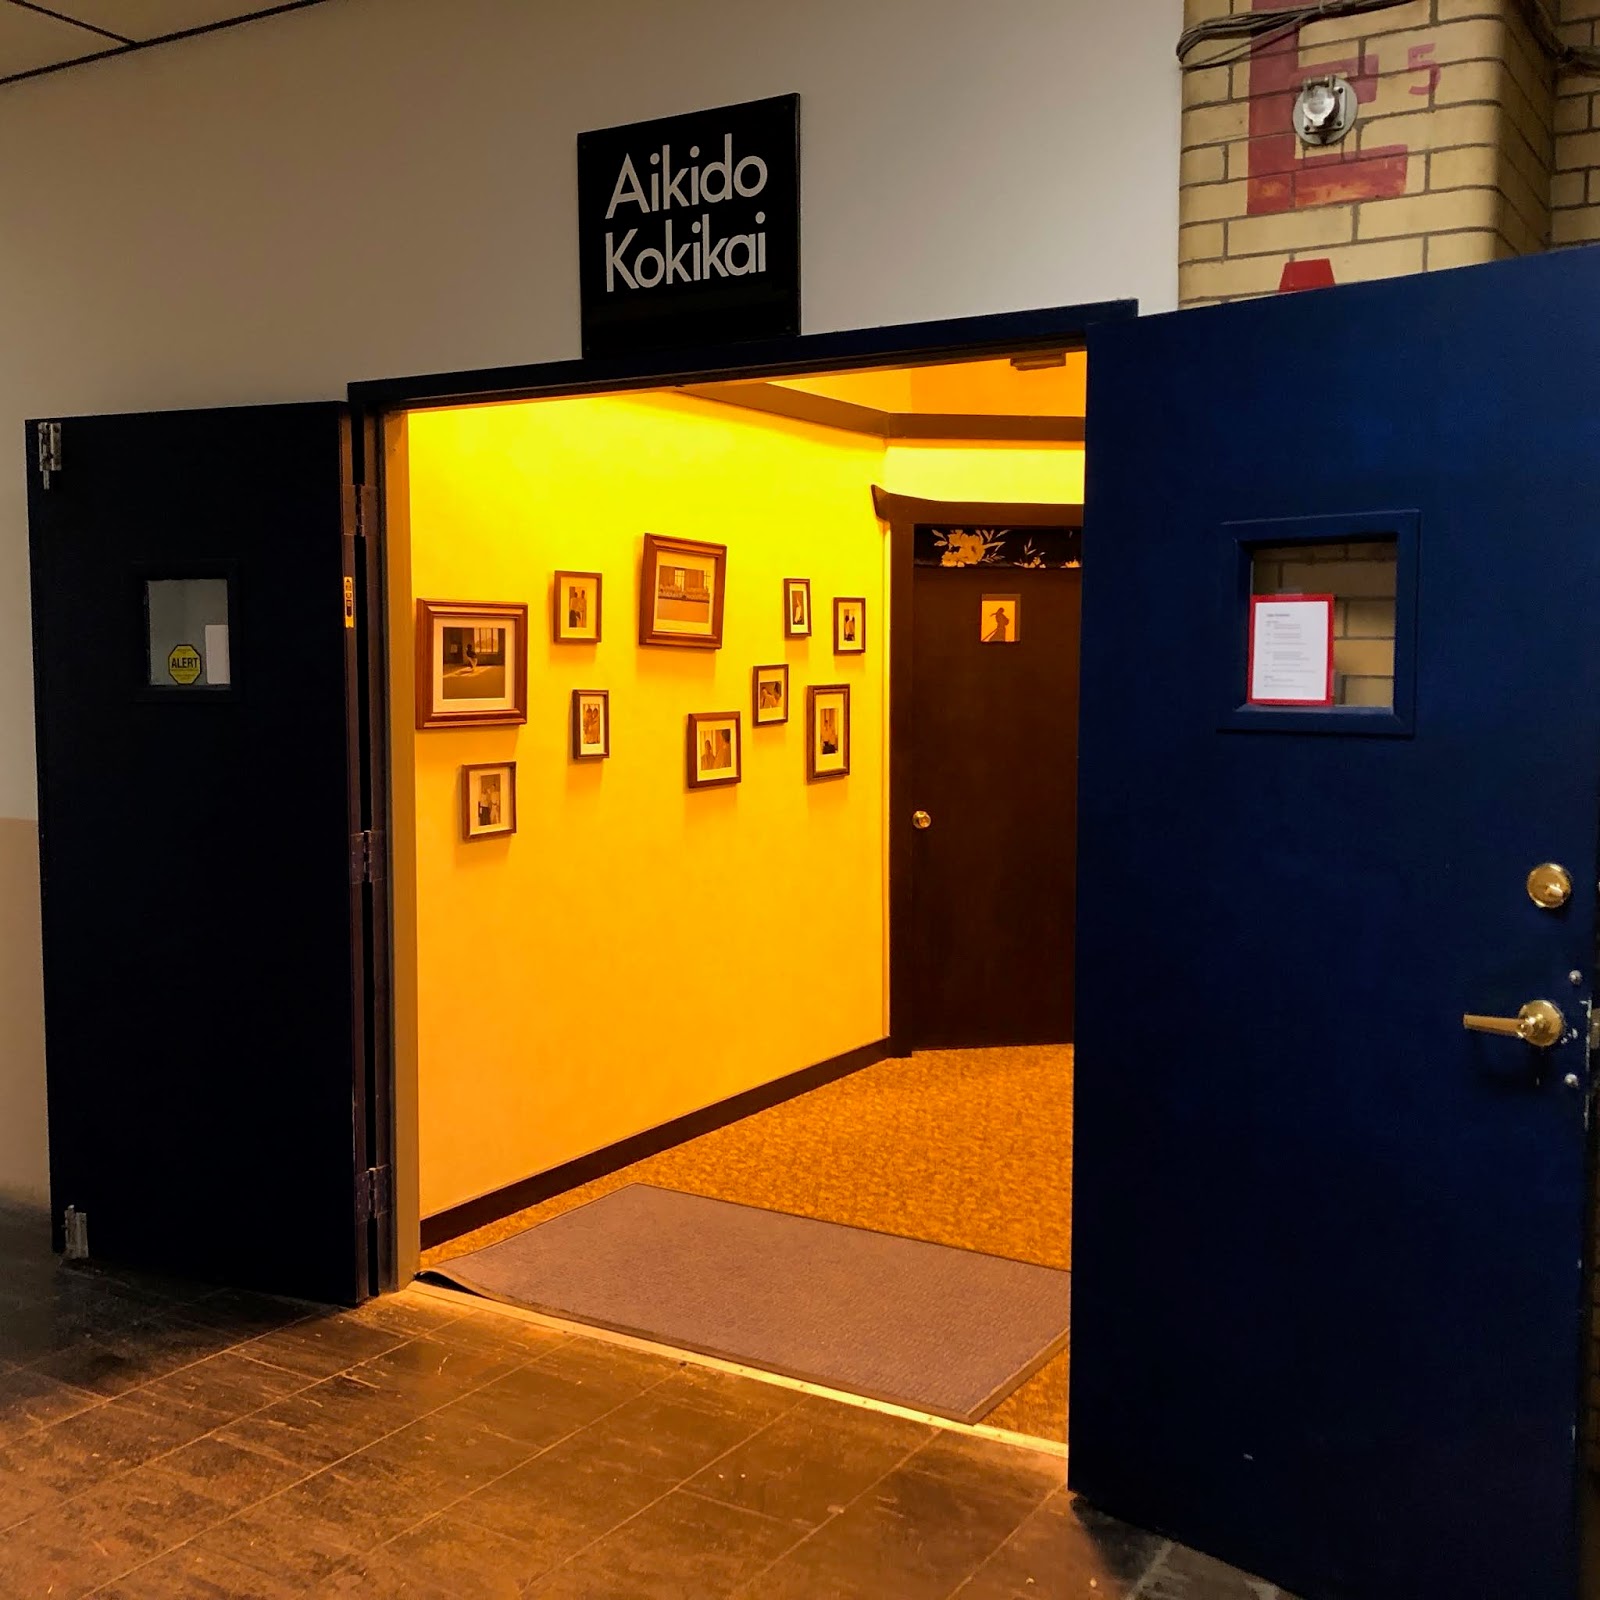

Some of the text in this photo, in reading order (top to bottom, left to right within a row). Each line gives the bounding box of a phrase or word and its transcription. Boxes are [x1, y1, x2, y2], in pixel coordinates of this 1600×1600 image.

[1407, 43, 1441, 96] 5
[605, 133, 768, 219] Aikido
[605, 211, 766, 292] Kokikai
[171, 657, 198, 668] ALERT
